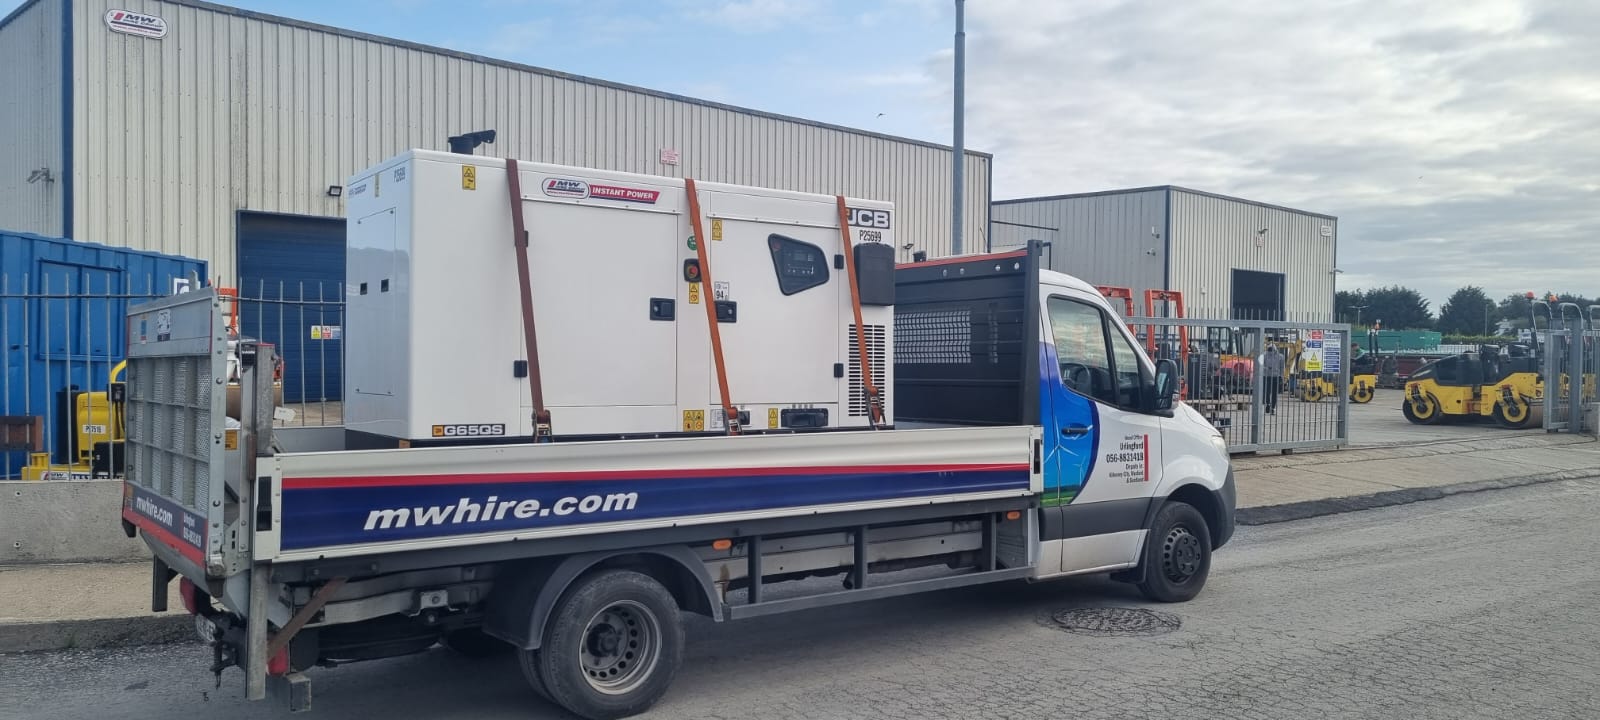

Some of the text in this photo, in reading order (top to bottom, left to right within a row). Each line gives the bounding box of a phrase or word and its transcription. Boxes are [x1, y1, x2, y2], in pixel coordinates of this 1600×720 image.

[125, 14, 157, 23] MW
[592, 187, 625, 197] INSTANT
[626, 190, 654, 199] POWER
[847, 209, 889, 228] JCB
[859, 230, 882, 242] P25699
[444, 425, 503, 436] G65QS
[136, 496, 174, 527] mwhire.com
[363, 492, 638, 531] mwhire.com
